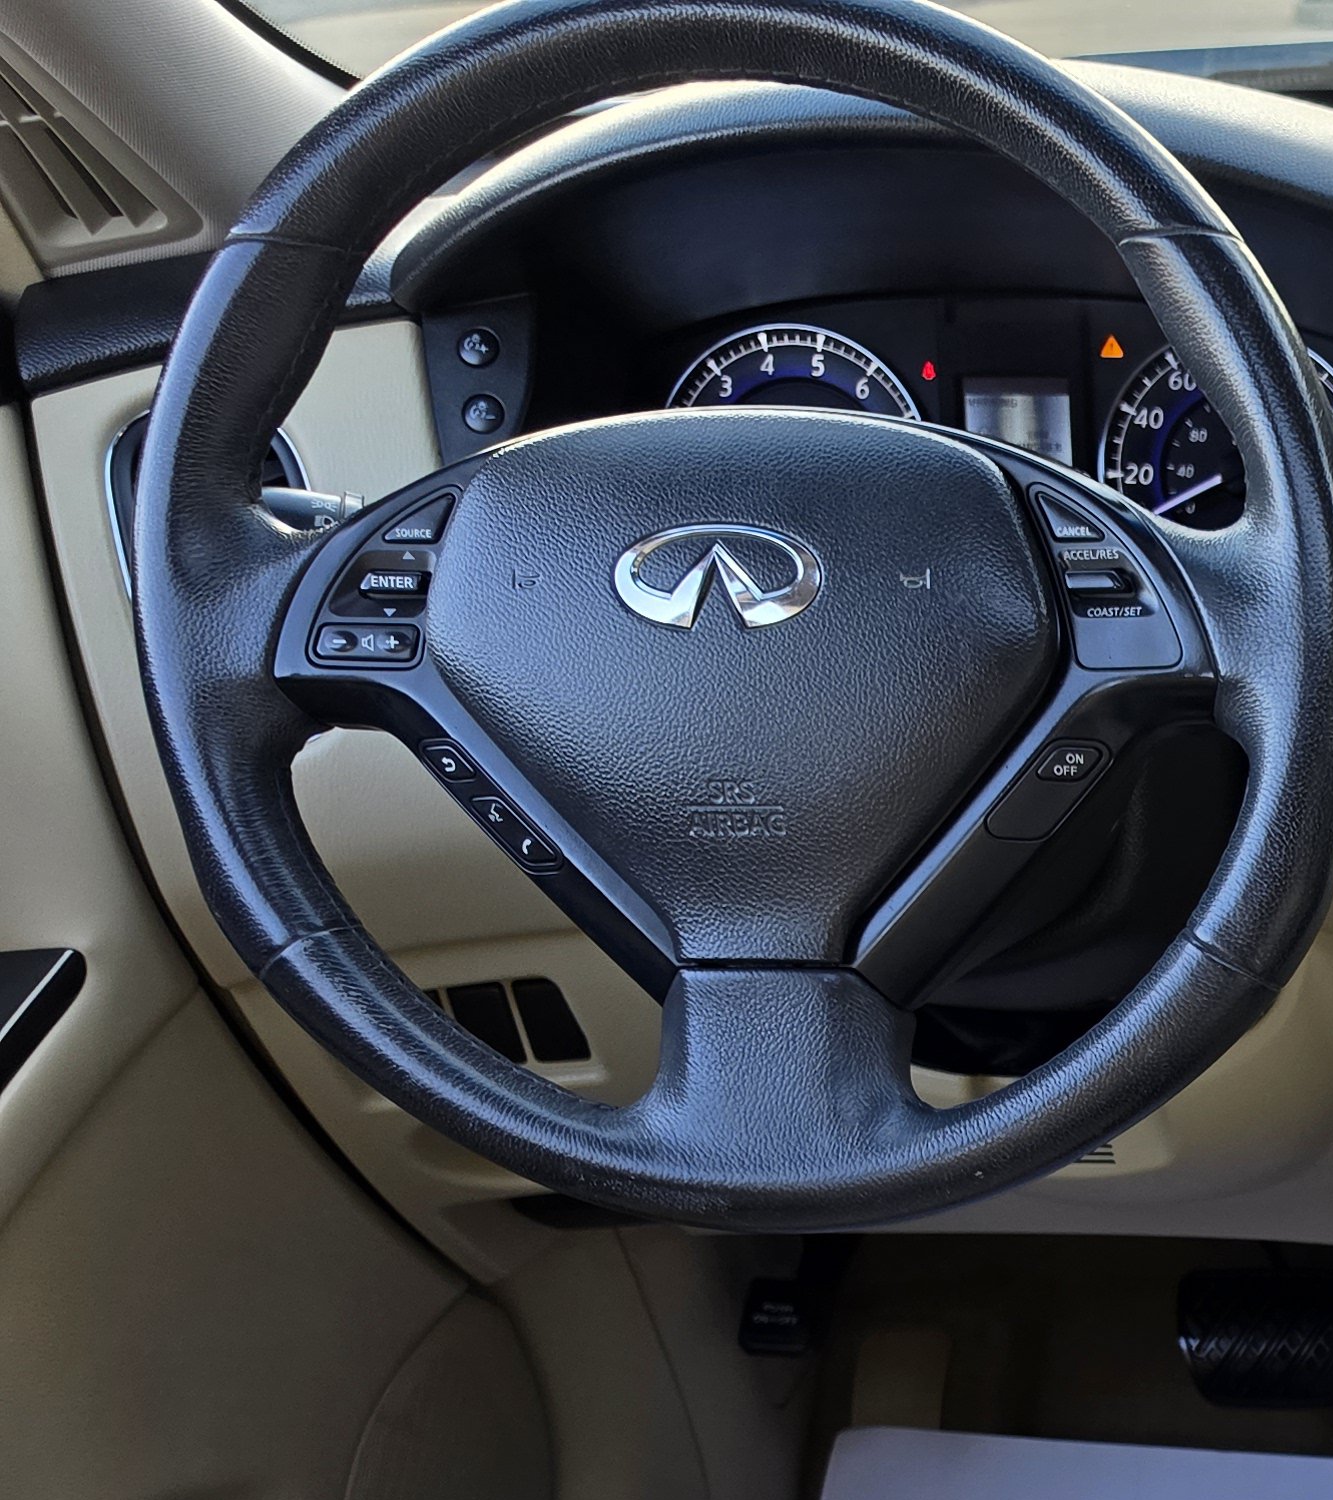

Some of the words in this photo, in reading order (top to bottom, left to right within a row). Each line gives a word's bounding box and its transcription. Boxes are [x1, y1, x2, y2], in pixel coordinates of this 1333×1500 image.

[760, 354, 776, 376] 4
[810, 354, 826, 377] 5
[718, 377, 734, 397] 3
[855, 377, 871, 399] 6
[1133, 406, 1164, 430] 40
[1188, 427, 1208, 443] 80
[1123, 463, 1154, 485] 20
[1176, 464, 1195, 479] 40
[395, 528, 432, 539] SOURCE
[1056, 526, 1092, 537] CANCEL
[1063, 548, 1120, 561] ACCEL/RES
[370, 575, 415, 589] ENTER
[1086, 606, 1143, 618] COAST/SET
[1065, 753, 1084, 765] ON
[1053, 765, 1079, 776] OFF
[708, 780, 756, 805] SRS
